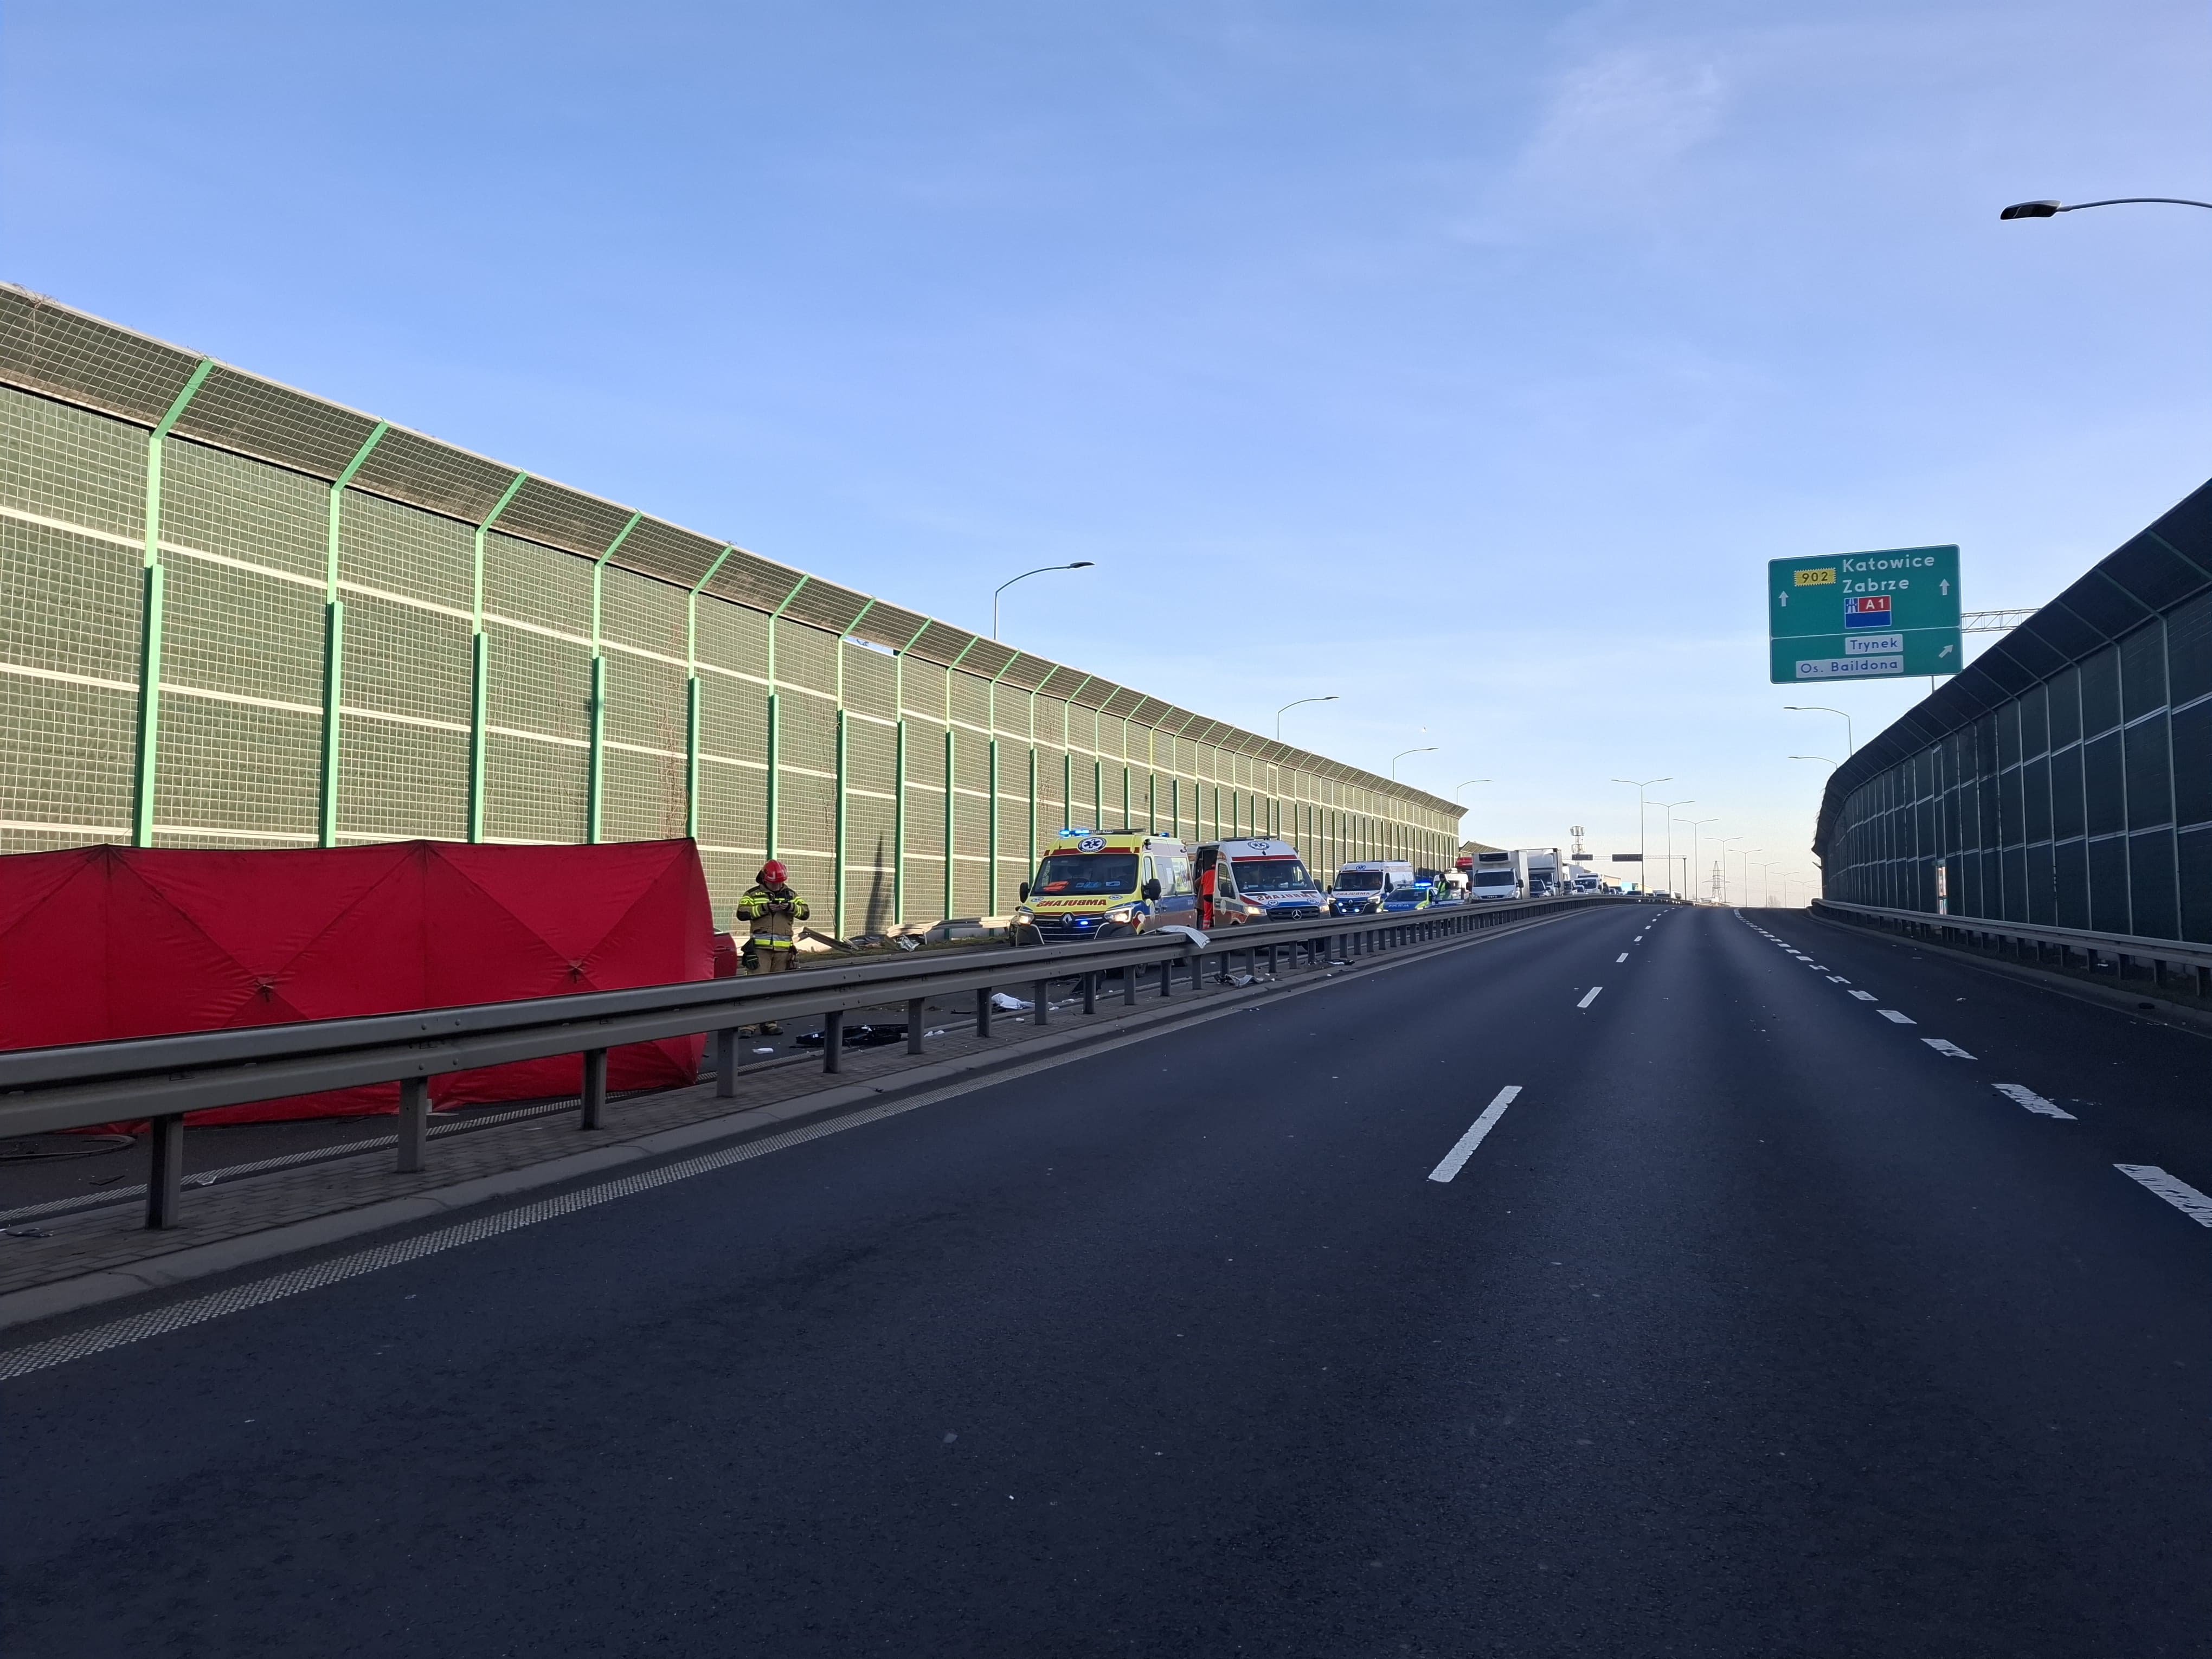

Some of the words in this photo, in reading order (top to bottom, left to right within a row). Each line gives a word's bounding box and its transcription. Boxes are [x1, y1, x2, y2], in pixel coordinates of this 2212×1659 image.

[1843, 554, 1935, 573] Katowice
[1802, 571, 1828, 583] 902
[1843, 578, 1909, 593] Zabrze
[1866, 599, 1885, 610] A1
[1850, 638, 1898, 652] Trynek
[1800, 663, 1824, 673] Os.
[1831, 660, 1898, 672] Baildona
